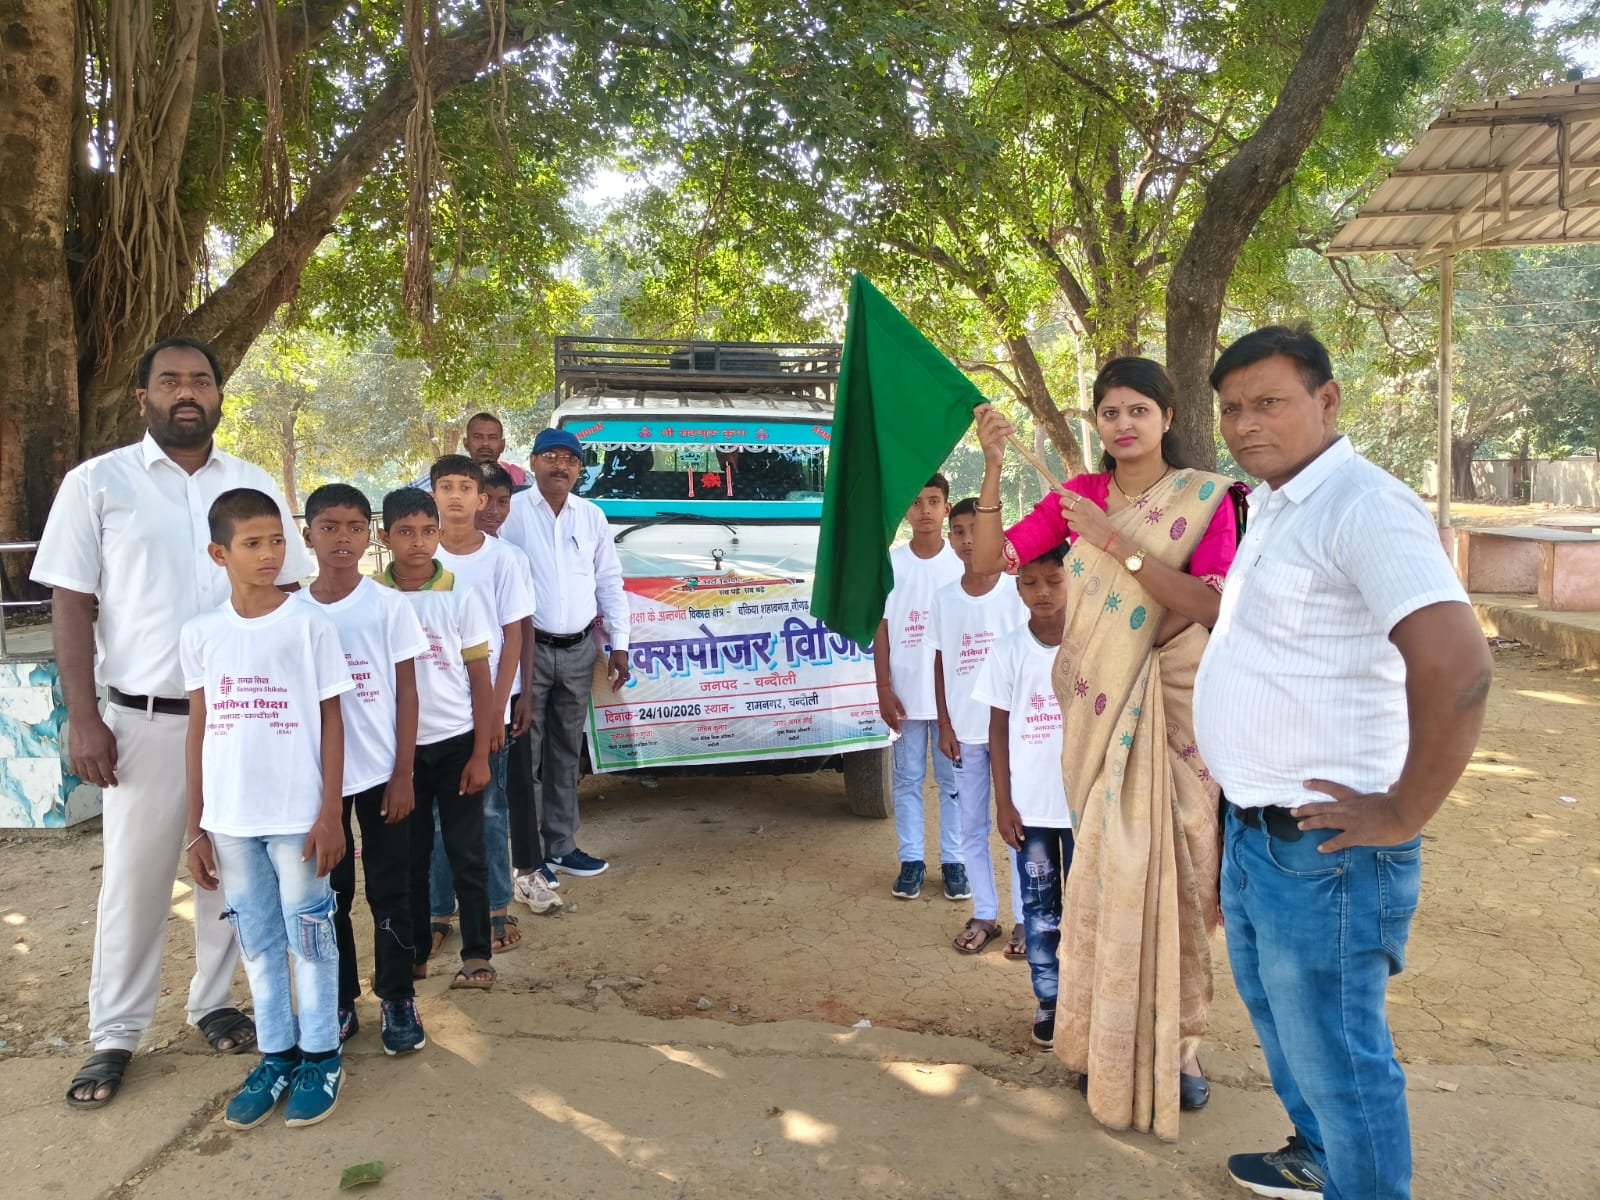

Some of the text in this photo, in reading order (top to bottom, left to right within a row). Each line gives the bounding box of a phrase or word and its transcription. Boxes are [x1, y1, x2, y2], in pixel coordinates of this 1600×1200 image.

[813, 425, 832, 441] ARM
[647, 607, 656, 622] के
[689, 606, 710, 620] विकास
[604, 621, 771, 680] क्सपोजर
[699, 679, 738, 693] जनपद
[754, 671, 797, 688] चन्दौली
[253, 698, 289, 709] शिक्षा
[639, 704, 702, 720] 24/10/2026
